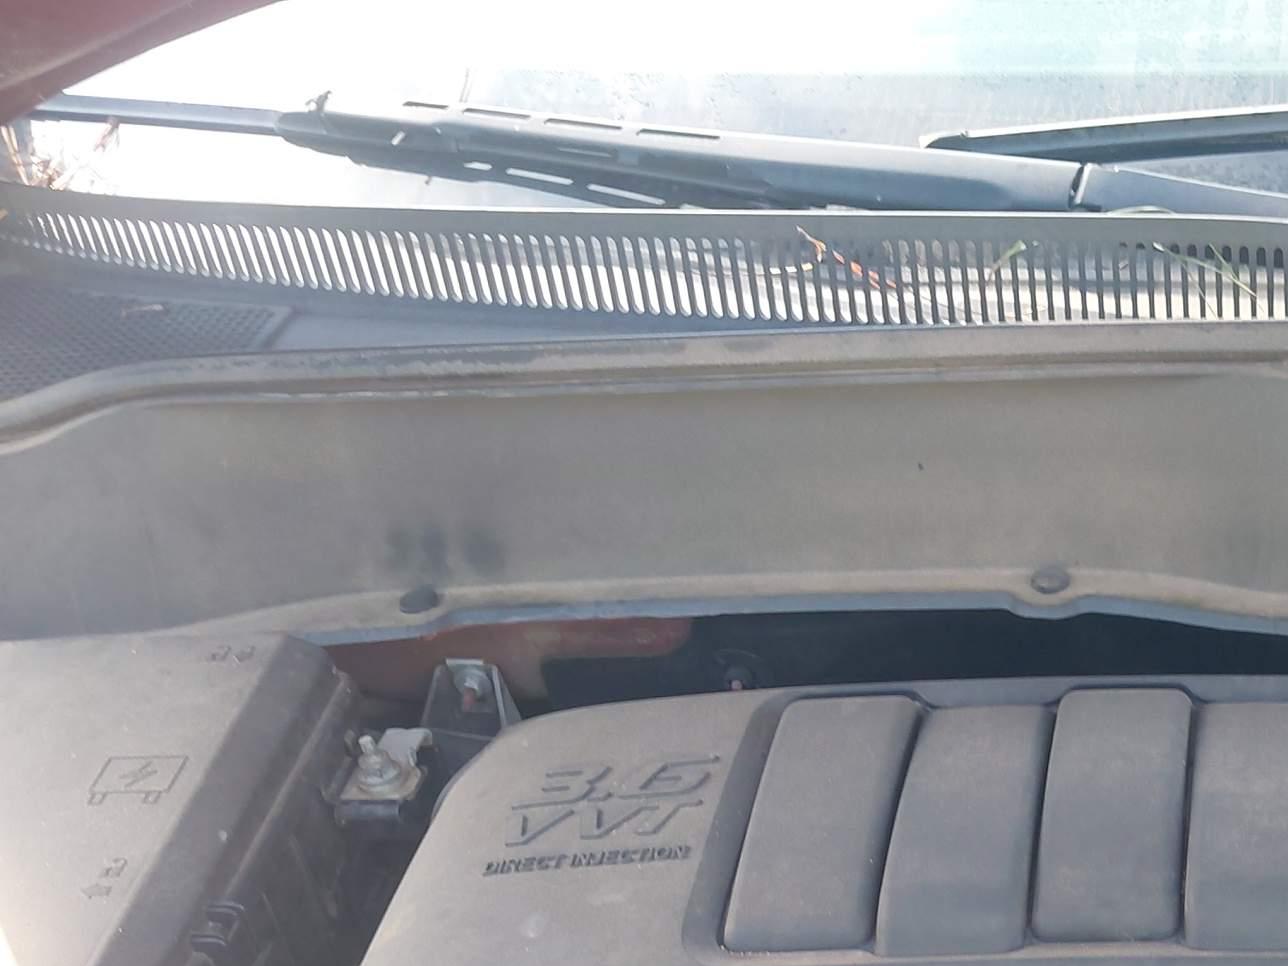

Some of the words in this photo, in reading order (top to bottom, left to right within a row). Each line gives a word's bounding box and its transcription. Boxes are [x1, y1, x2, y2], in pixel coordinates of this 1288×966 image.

[512, 755, 720, 810] 3.6
[505, 800, 703, 848] VVT
[483, 854, 565, 877] DIRECT
[568, 847, 692, 868] INJECTION
